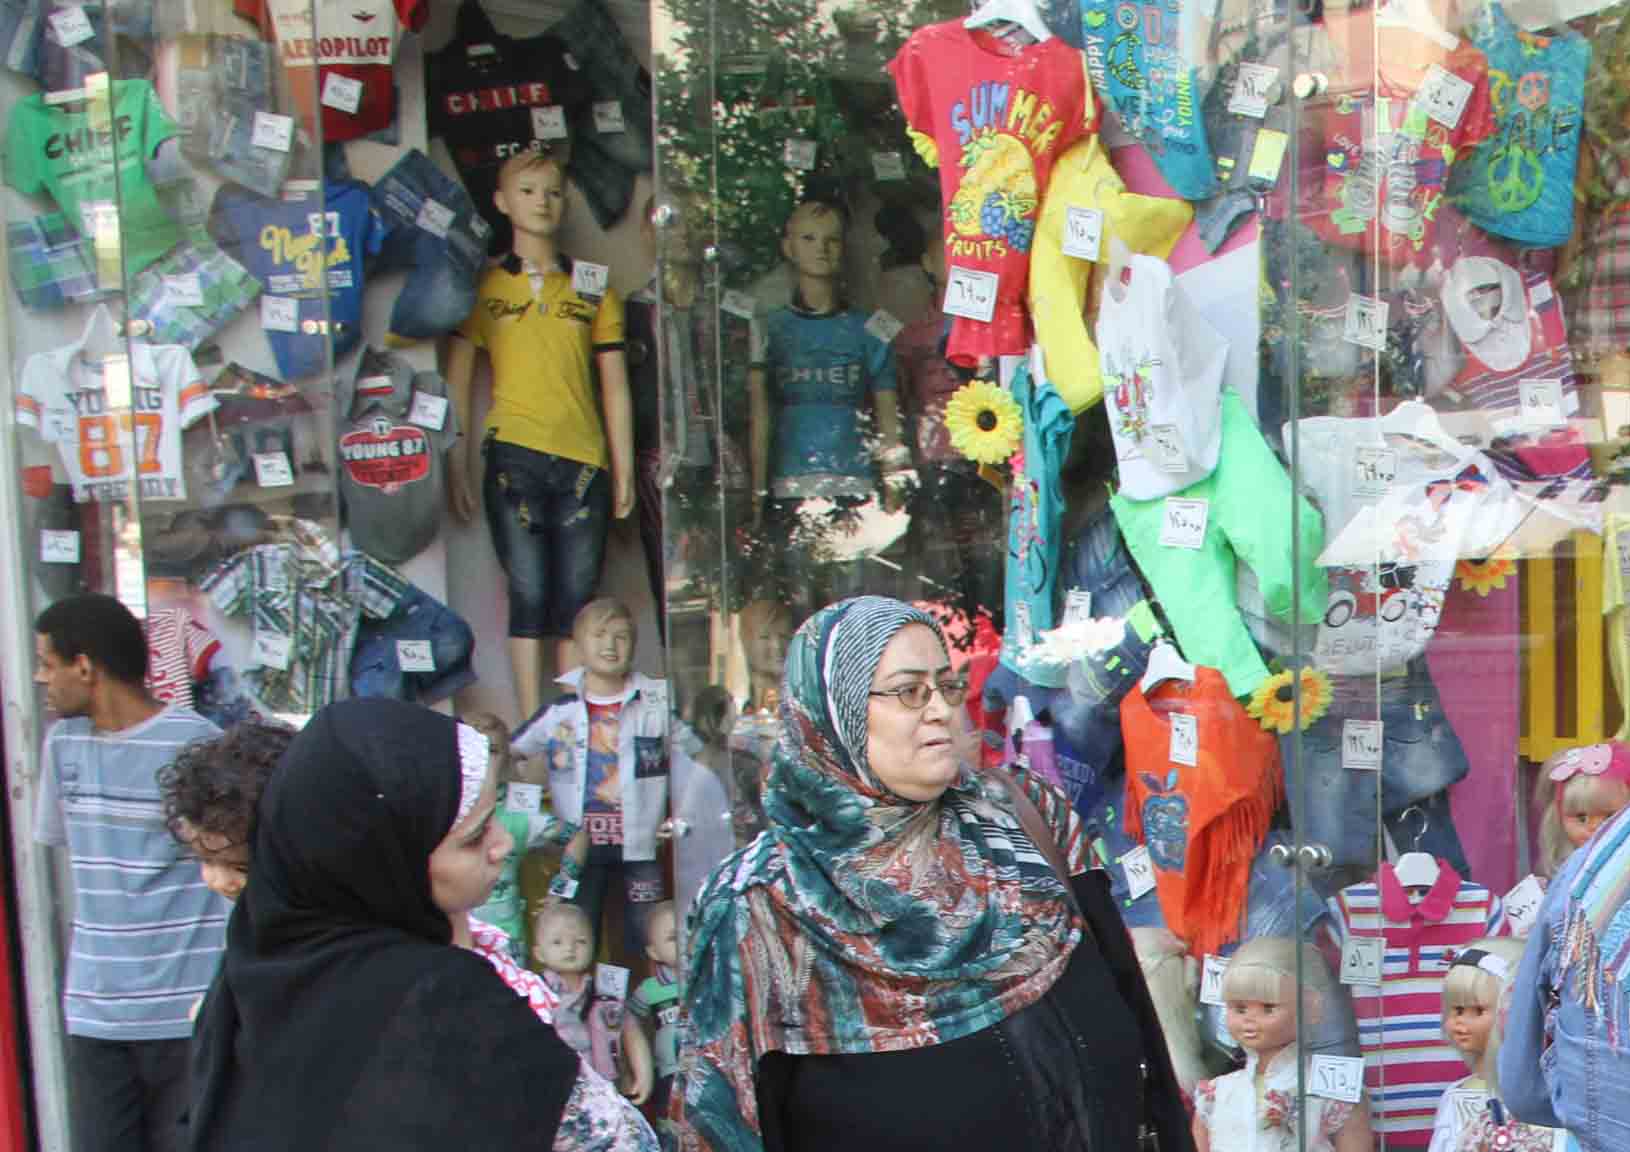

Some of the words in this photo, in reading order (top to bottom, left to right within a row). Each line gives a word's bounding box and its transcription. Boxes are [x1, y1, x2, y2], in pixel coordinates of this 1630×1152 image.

[951, 80, 1063, 154] SUMMER
[946, 231, 1009, 260] FRUITS
[79, 411, 161, 478] 87
